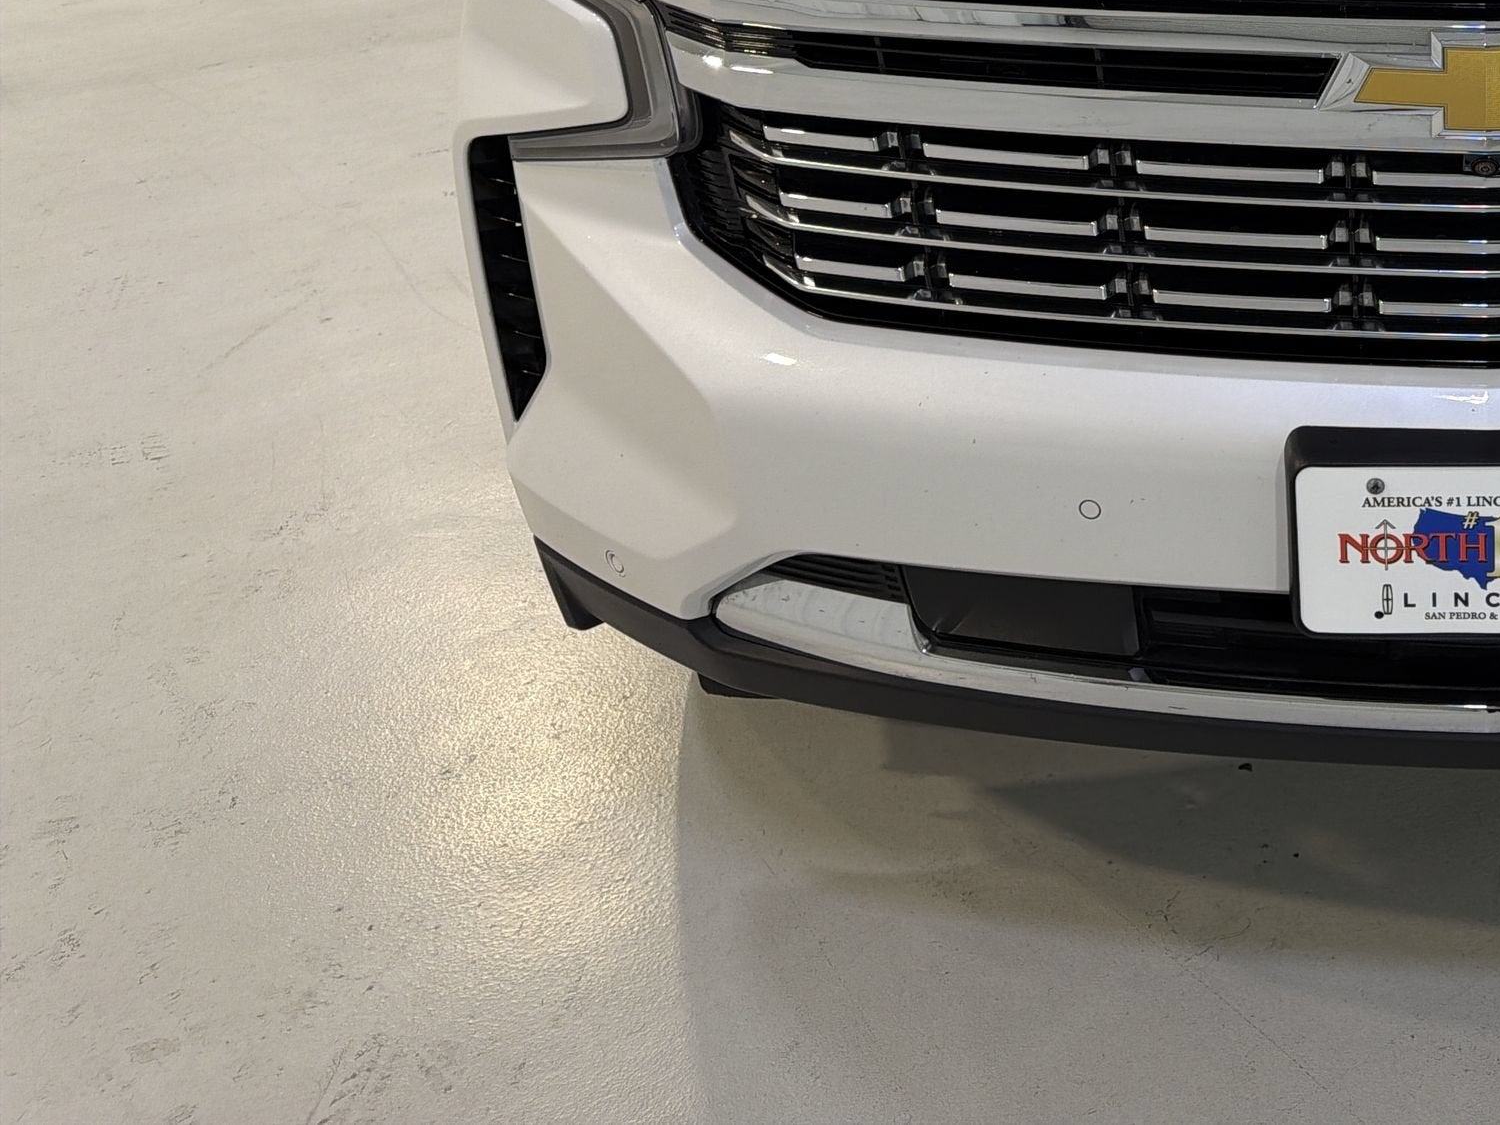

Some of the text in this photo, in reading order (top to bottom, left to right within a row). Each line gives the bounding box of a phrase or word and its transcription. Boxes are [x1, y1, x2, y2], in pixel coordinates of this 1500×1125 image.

[1361, 496, 1443, 508] AMERICA'S
[1446, 496, 1462, 508] #1
[1338, 531, 1488, 565] NORTH
[1424, 611, 1447, 621] SAN
[1448, 611, 1487, 621] PEDRO
[1489, 611, 1499, 621] &
